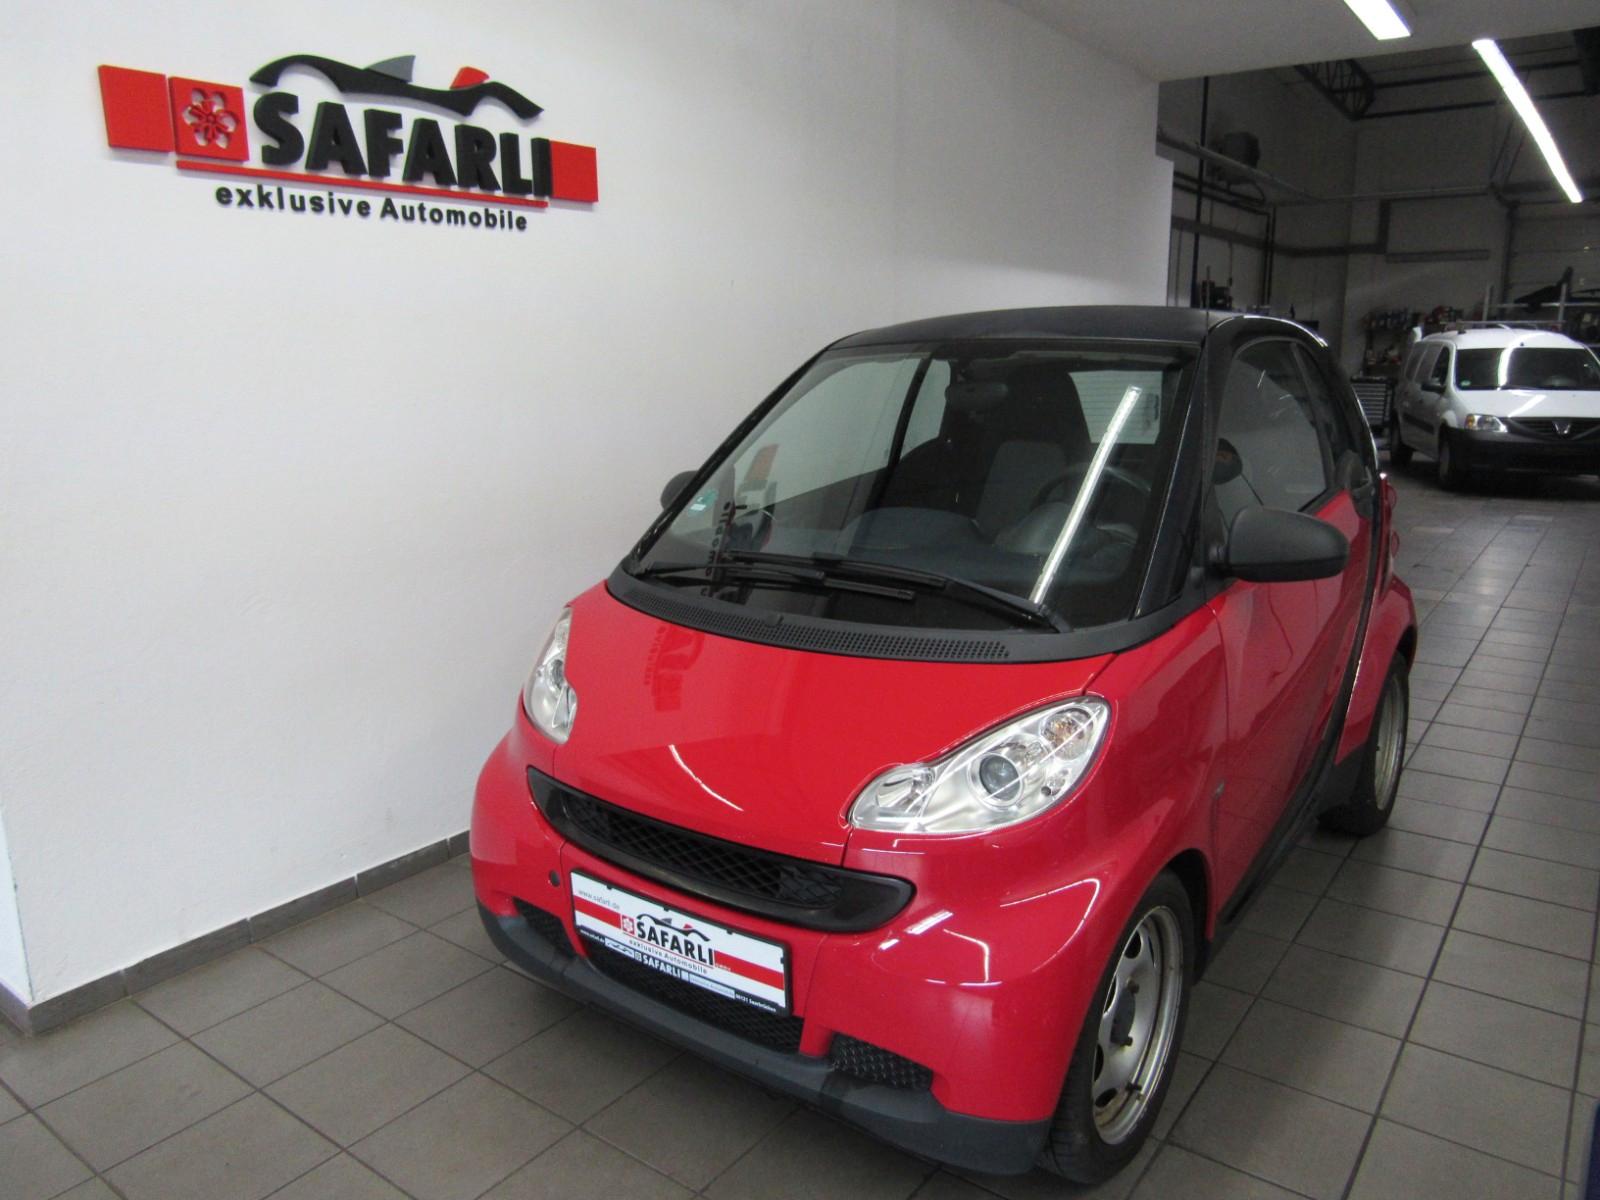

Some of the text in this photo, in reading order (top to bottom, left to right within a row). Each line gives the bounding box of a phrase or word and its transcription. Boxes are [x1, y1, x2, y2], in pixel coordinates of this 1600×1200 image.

[253, 91, 552, 198] SAFARLI
[216, 185, 528, 230] exklusive Automobile
[636, 922, 714, 966] SAFARLI
[642, 953, 681, 979] SAFARLI
[664, 953, 708, 974] Automobile
